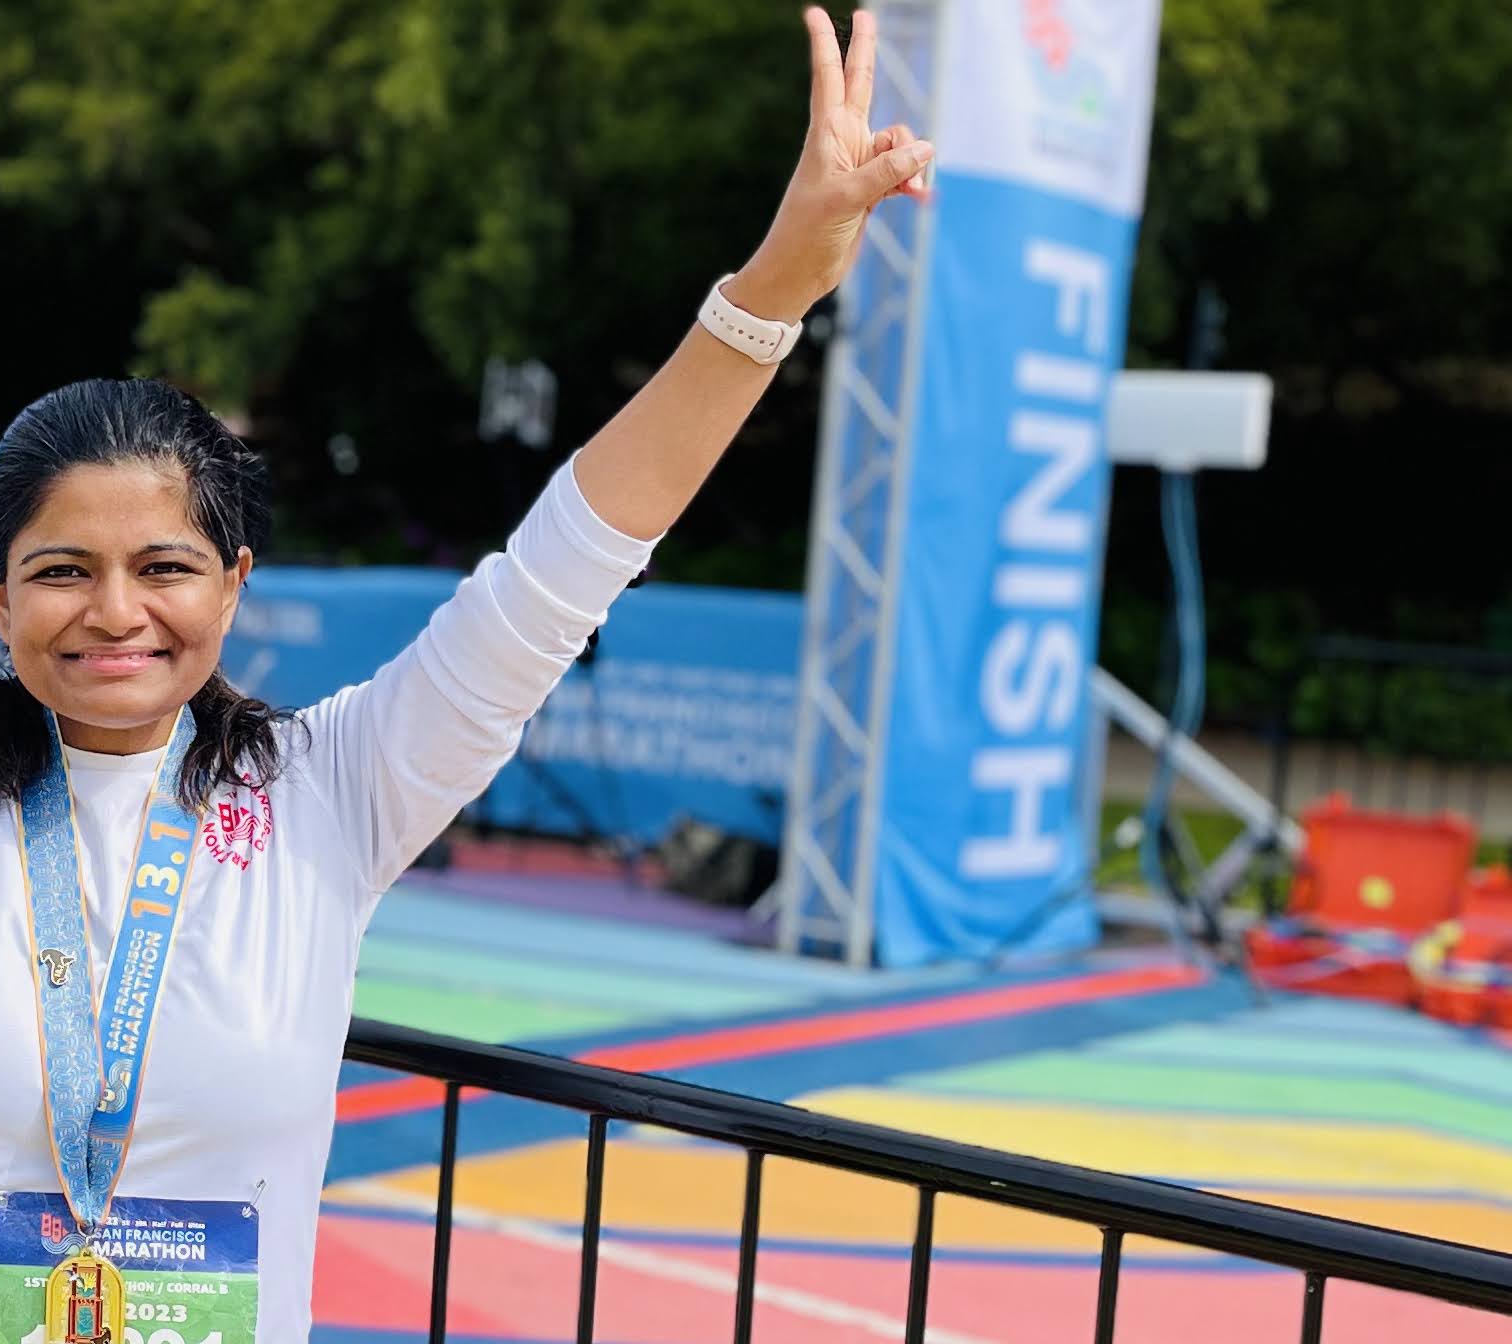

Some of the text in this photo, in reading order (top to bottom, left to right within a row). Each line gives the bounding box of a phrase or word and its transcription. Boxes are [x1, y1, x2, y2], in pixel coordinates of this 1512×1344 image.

[958, 237, 1109, 884] FINISH
[130, 820, 191, 919] 13.1
[106, 928, 145, 1052] SAN FRANCISCO
[120, 930, 163, 1055] MARATHON
[93, 1241, 206, 1260] MARATHON
[95, 1229, 206, 1243] SAN FRANCISCO
[125, 1303, 187, 1322] 2023
[167, 1282, 216, 1294] CORRAL
